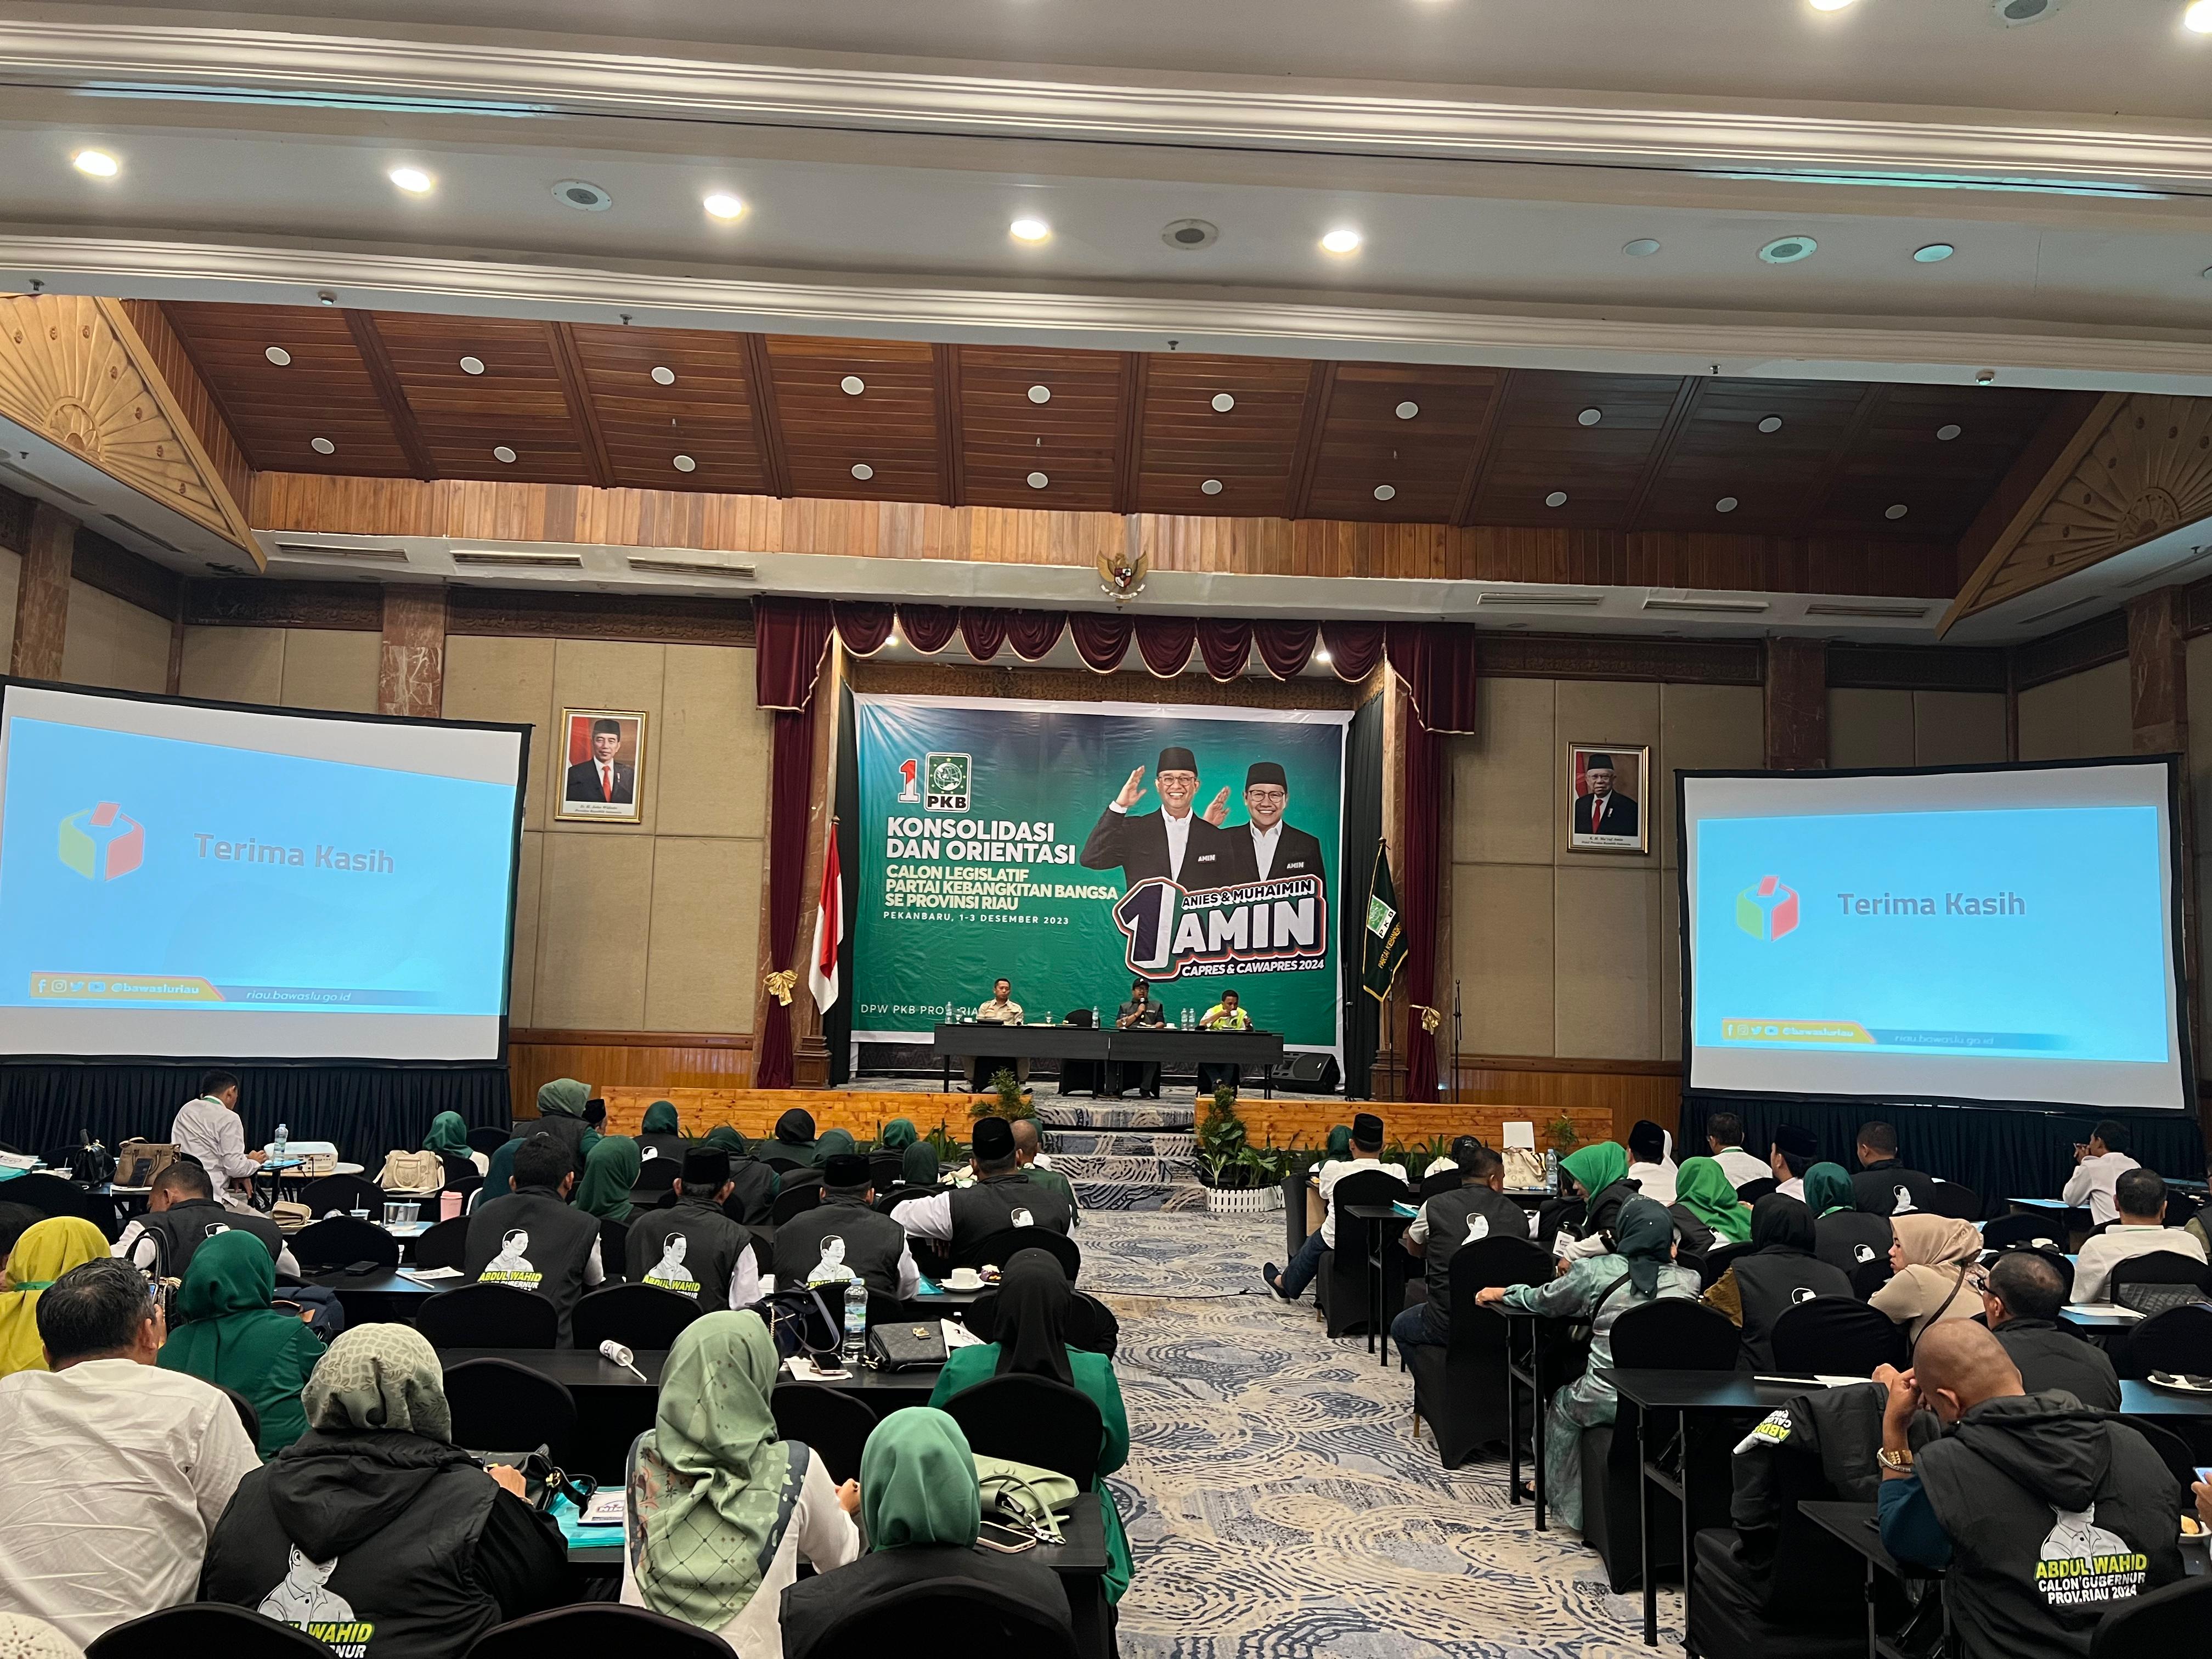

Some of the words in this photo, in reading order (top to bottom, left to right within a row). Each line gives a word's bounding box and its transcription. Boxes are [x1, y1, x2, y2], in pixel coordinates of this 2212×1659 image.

[927, 795, 966, 809] PKB
[887, 816, 1054, 843] KONSOLIDASI
[194, 833, 304, 867] Terima
[315, 844, 394, 873] Kasih
[886, 838, 940, 860] DAN
[945, 840, 1076, 865] ORIENTASI
[886, 865, 943, 879] CALON
[945, 866, 1030, 883] LEGISLATIF
[885, 879, 940, 894] PARTAI
[943, 881, 1052, 898] KEBANGKITAN
[1054, 884, 1119, 900] BANGSA
[1182, 893, 1218, 909] ANIES
[1221, 891, 1231, 904] &
[1233, 879, 1313, 901] MUHAIMIN
[884, 893, 904, 907] SE
[906, 894, 978, 909] PROVINSI
[981, 896, 1019, 911] RIAU
[1837, 893, 1936, 916] Terima
[1945, 891, 2025, 916] Kasih
[883, 911, 953, 922] PEKANBARU,
[959, 914, 975, 922] 1-3
[980, 915, 1039, 924] DESEMBER
[1043, 917, 1069, 925] 2023
[1119, 882, 1171, 966] 1
[1172, 897, 1314, 954] AMIN
[1182, 963, 1226, 977] CAPRES
[1228, 963, 1234, 974] &
[1237, 960, 1297, 973] CAWAPRES
[1299, 959, 1324, 970] 2024
[246, 990, 352, 1003] riau.bawaslu.go.id
[861, 1004, 888, 1013] DPW
[893, 1005, 916, 1014] PKB
[920, 1006, 949, 1015] PRO
[960, 1007, 979, 1016] RIA
[477, 1272, 508, 1282] ABDUL
[510, 1272, 543, 1282] WAHID
[672, 1280, 701, 1291] WAHID
[2036, 1559, 2091, 1578] ABDUL
[2093, 1554, 2147, 1574] WAHID
[2038, 1578, 2079, 1592] CALON
[2082, 1572, 2146, 1589] GUBERNUR
[2112, 1584, 2137, 1599] 2024
[308, 1623, 373, 1643] WAHID
